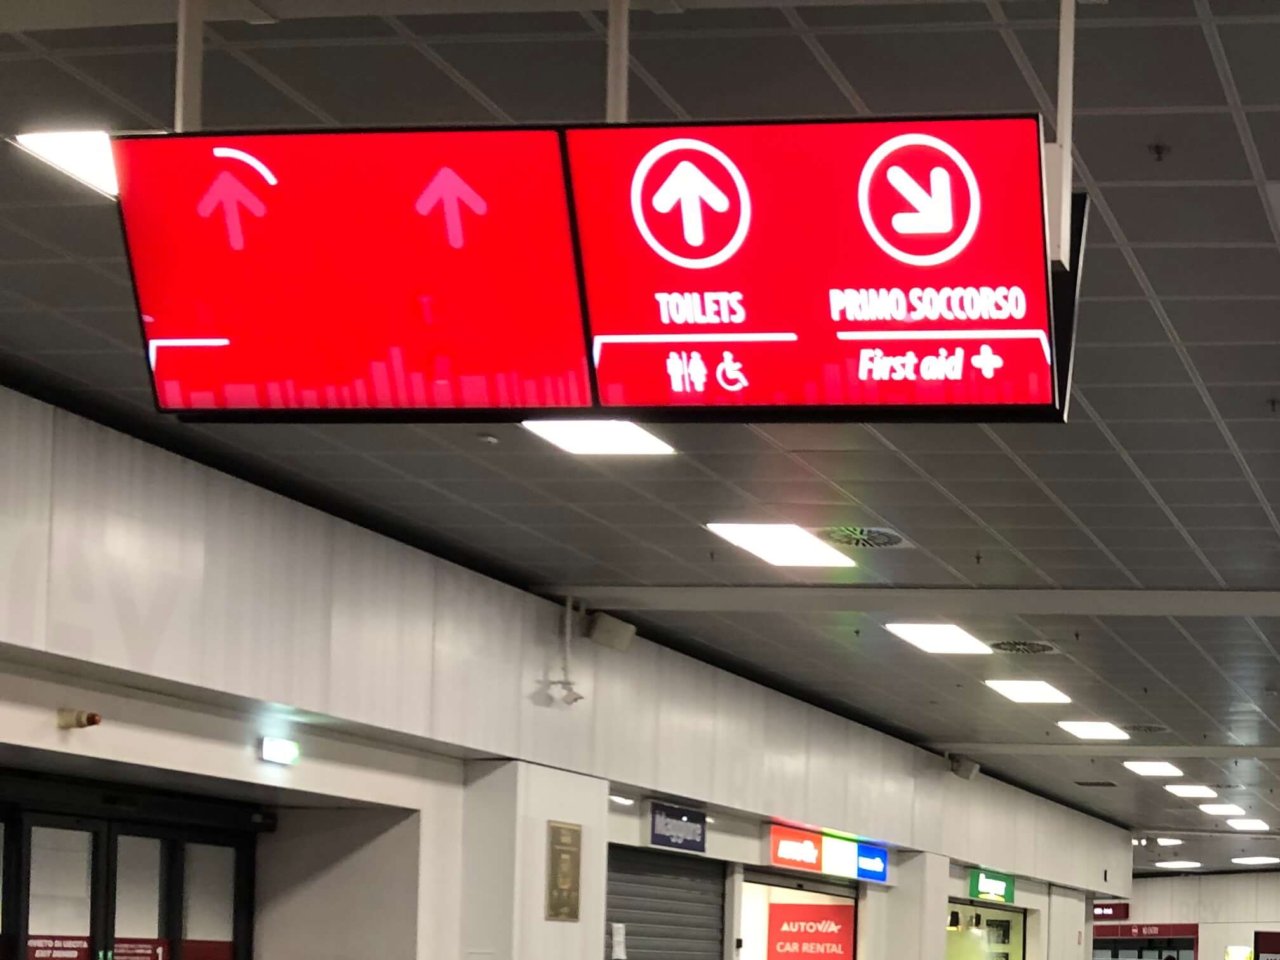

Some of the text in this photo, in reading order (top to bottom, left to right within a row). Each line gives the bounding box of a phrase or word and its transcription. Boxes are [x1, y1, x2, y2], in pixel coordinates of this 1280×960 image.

[654, 291, 746, 325] TOILETS
[828, 285, 1028, 322] PRIMO SOCCORSO
[857, 346, 965, 382] First aid
[775, 941, 845, 955] CAR RENTAL
